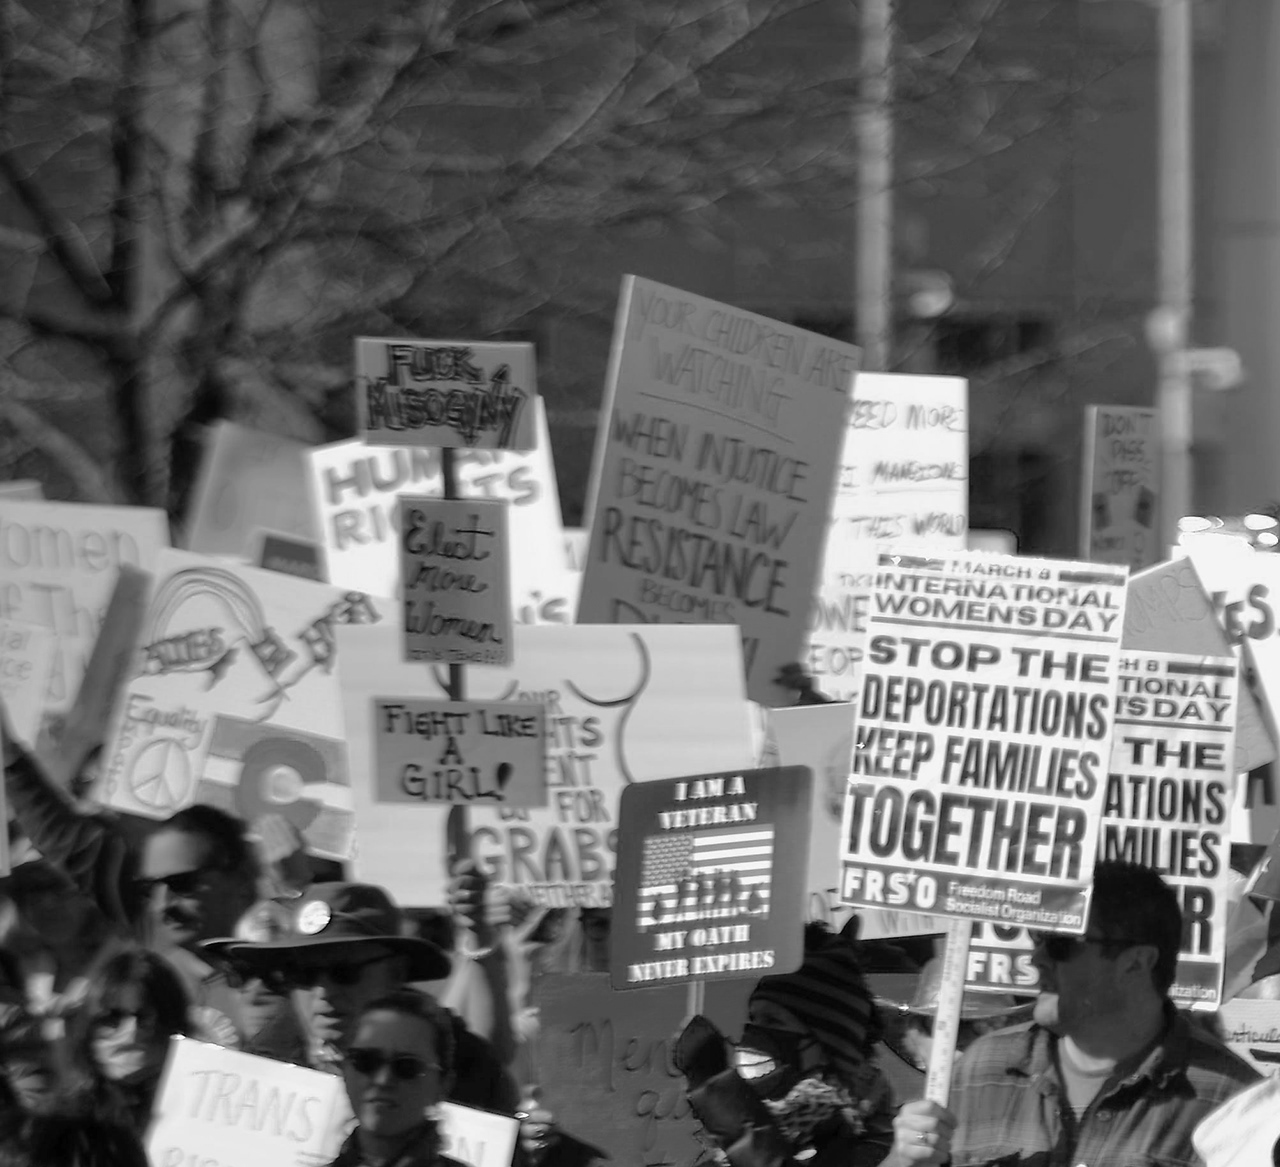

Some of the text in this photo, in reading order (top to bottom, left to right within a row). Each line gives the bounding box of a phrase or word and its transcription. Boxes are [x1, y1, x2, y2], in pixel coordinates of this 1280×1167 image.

[649, 335, 793, 428] WATCHING
[806, 345, 857, 396] ARE
[612, 408, 689, 462] WHEN
[729, 494, 800, 550] LAW
[600, 506, 790, 620] RESISTANCE
[875, 572, 1121, 611] INTERNATIONAL
[1042, 606, 1120, 634] DAY
[867, 634, 1111, 684] STOP THE
[381, 703, 541, 741] FIGHT LIKE
[860, 672, 1109, 742] DEPORTATIONS
[1153, 700, 1232, 724] DAY
[440, 735, 464, 767] A
[853, 724, 1101, 802] KEEP FAMILIES
[1123, 737, 1226, 772] THE
[398, 762, 515, 803] GIRL!
[673, 775, 746, 801] I AM A
[557, 787, 612, 823] FOR
[658, 802, 759, 830] VETERAN
[845, 783, 1088, 881] TOGETHER
[842, 864, 939, 911] FRSO
[1006, 888, 1042, 905] Road
[945, 897, 1082, 928] Socialist Organization
[652, 924, 751, 952] MY OATH
[626, 949, 777, 984] NEVER EXPIRES
[187, 1068, 322, 1144] TRANS
